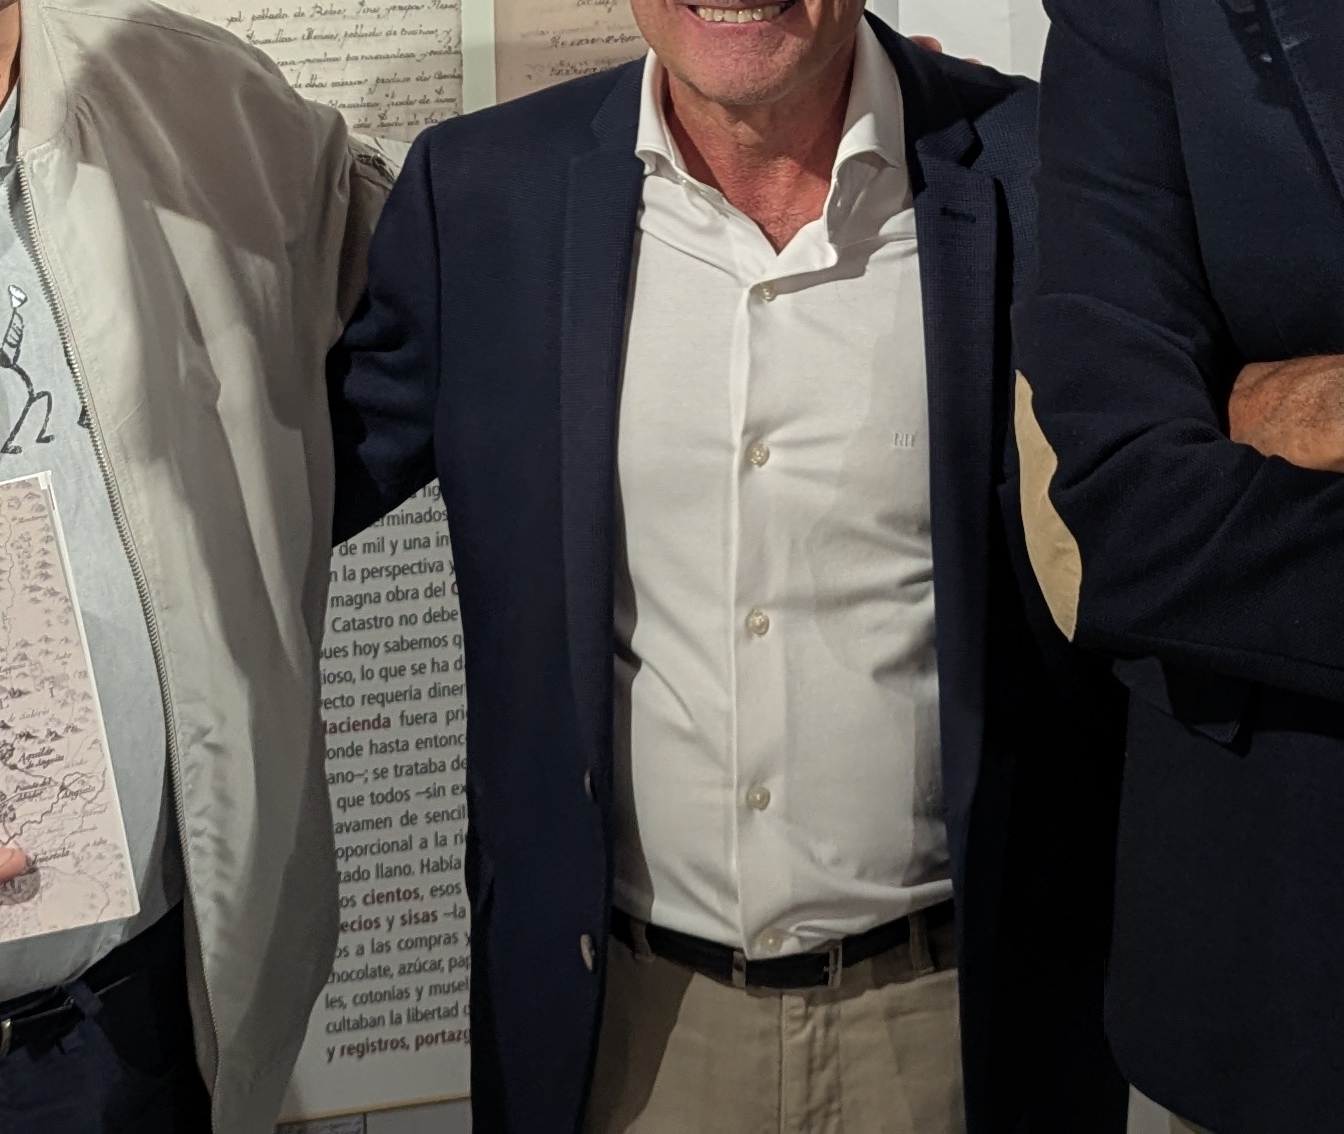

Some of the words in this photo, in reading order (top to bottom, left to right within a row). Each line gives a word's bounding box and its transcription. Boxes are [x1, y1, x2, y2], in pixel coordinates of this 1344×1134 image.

[342, 564, 356, 582] la
[360, 557, 444, 584] perspectiva
[330, 591, 381, 610] magna
[385, 585, 419, 602] obra
[423, 581, 445, 598] del
[331, 615, 394, 633] Catastro
[398, 612, 418, 626] no
[352, 640, 380, 659] hoy
[383, 634, 448, 654] sabemos
[360, 684, 421, 708] requería
[336, 794, 364, 812] que
[369, 786, 410, 805] todos
[375, 862, 414, 879] llano.
[419, 854, 460, 874] Había
[361, 887, 424, 906] cientos,
[429, 883, 461, 898] esos
[399, 908, 437, 926] sisas
[370, 937, 391, 954] las
[396, 932, 458, 951] compras
[397, 957, 444, 976] azúcar,
[389, 1009, 402, 1026] la
[406, 1001, 458, 1023] libertad
[326, 1046, 335, 1063] y
[339, 1036, 409, 1060] registros,
